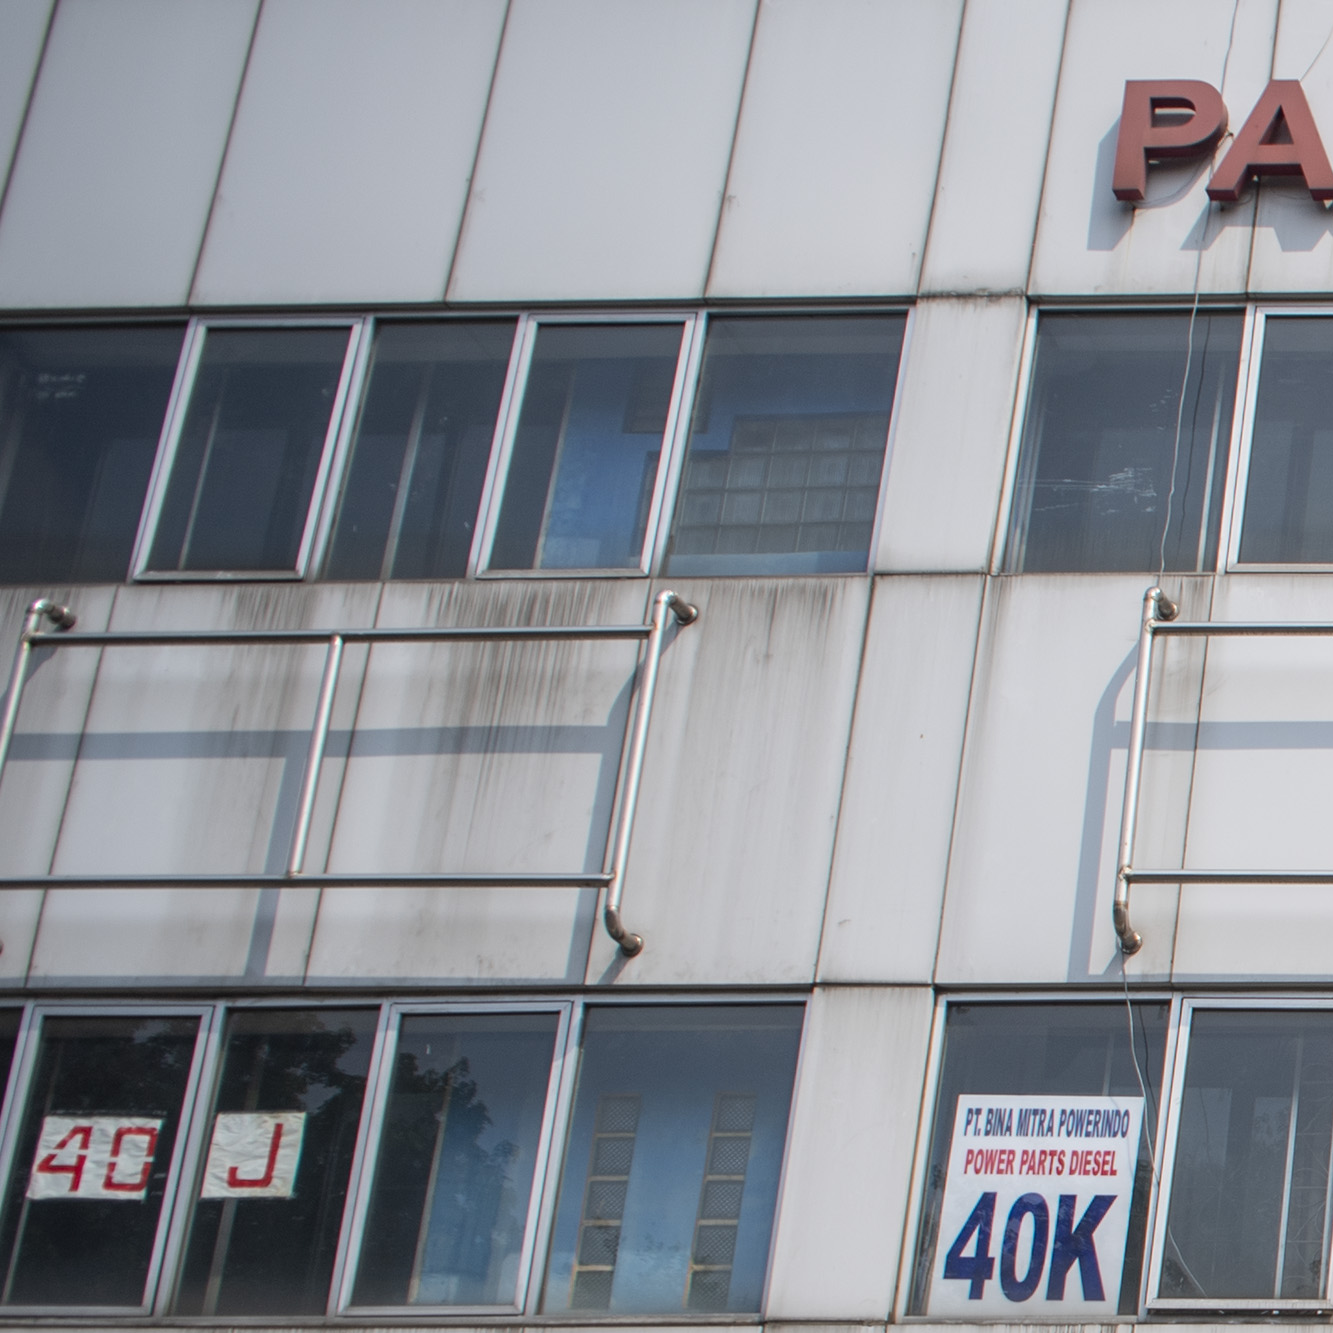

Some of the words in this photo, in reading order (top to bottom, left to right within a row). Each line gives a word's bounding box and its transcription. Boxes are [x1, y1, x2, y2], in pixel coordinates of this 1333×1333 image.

[963, 1108, 983, 1137] PT.
[984, 1108, 1013, 1137] BINA
[1016, 1109, 1055, 1137] MITRA
[1057, 1109, 1130, 1138] POWERINDO
[227, 1123, 283, 1188] J
[963, 1149, 1016, 1175] POWER
[1019, 1149, 1066, 1175] PARTS
[1068, 1150, 1118, 1176] DIESEL
[942, 1191, 1118, 1303] 40K
